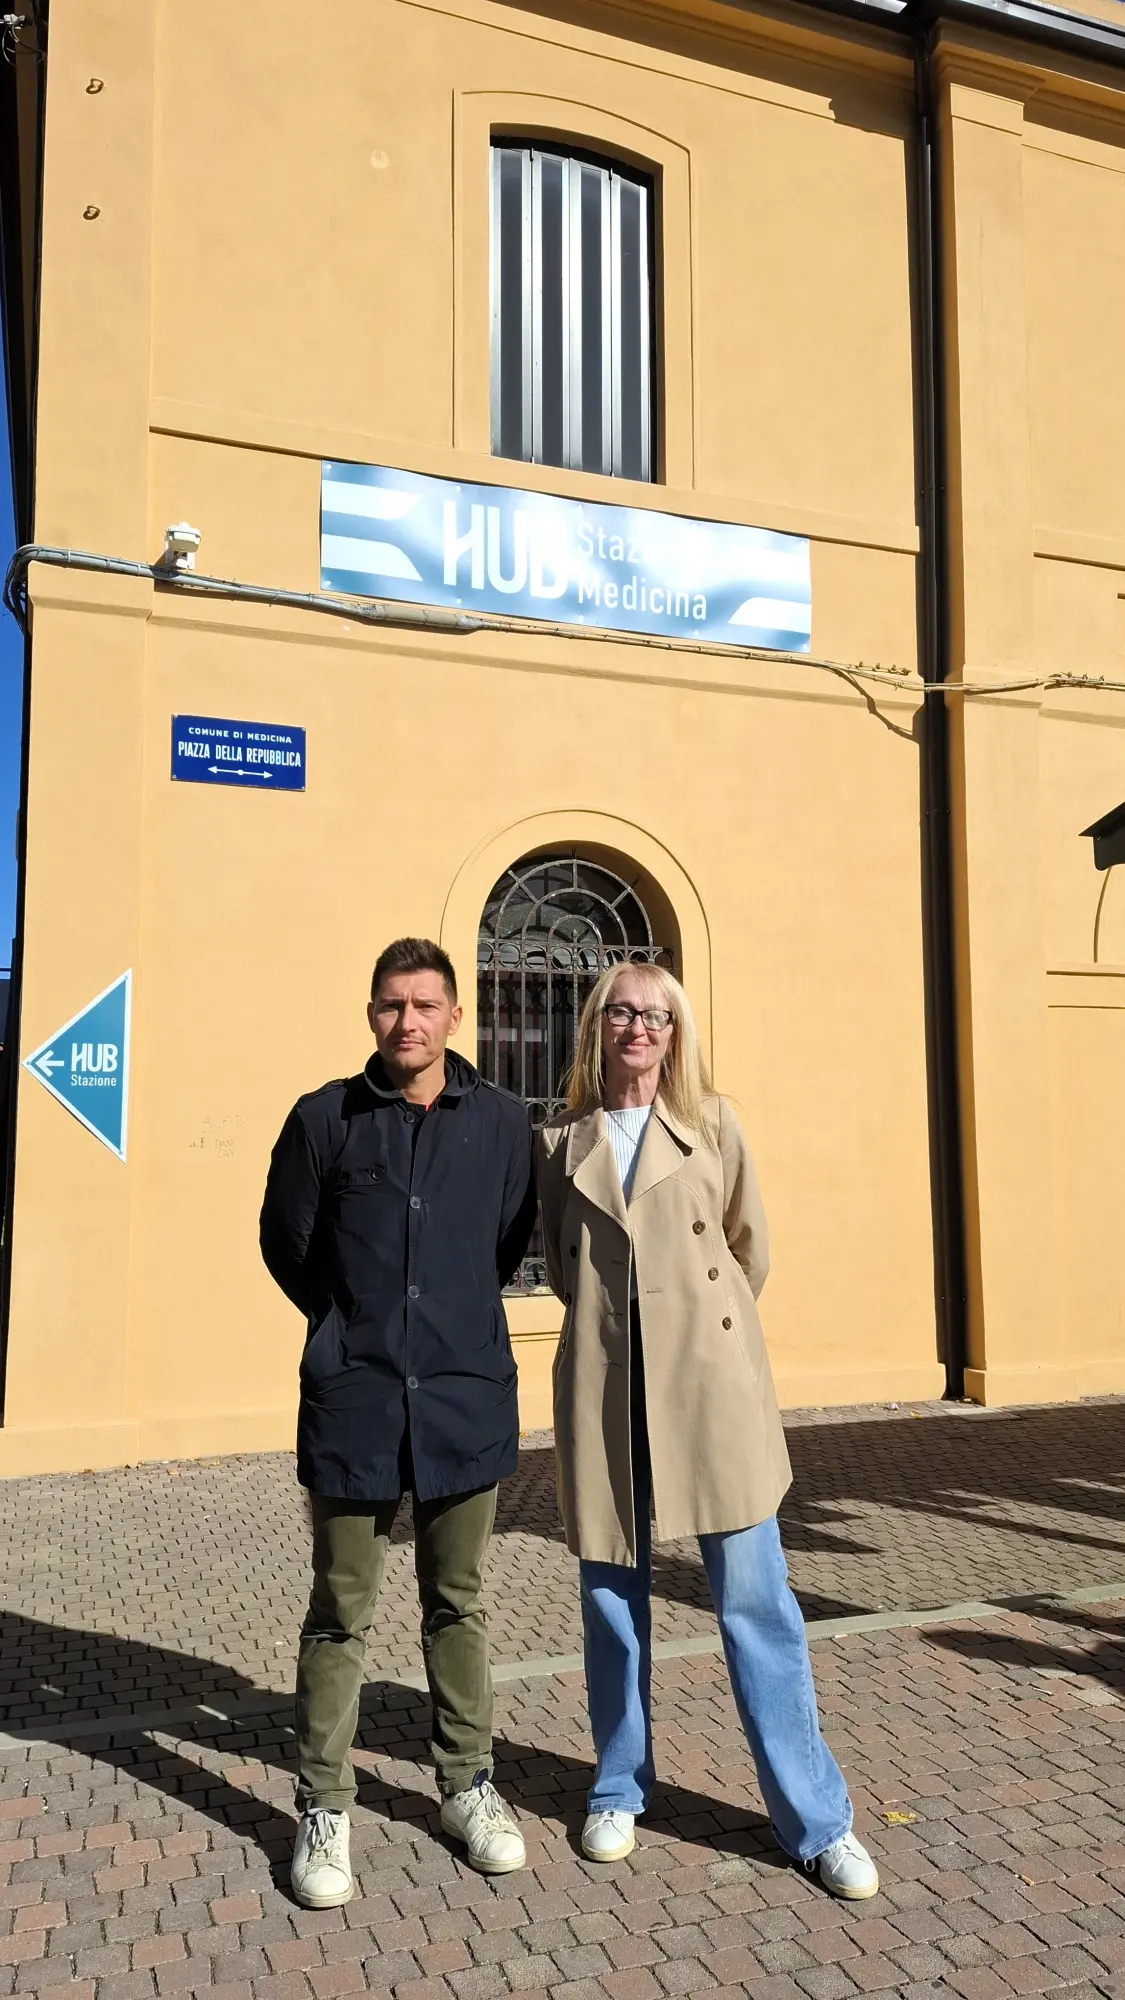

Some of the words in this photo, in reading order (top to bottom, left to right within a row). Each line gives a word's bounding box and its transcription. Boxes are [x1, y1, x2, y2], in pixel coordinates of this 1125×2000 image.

[578, 572, 707, 620] Medicina
[188, 727, 229, 738] COMUNE
[233, 731, 243, 739] DI
[247, 733, 292, 744] MEDICINA
[178, 741, 210, 758] PIAZZA
[215, 744, 242, 761] DELLA
[246, 747, 301, 767] REPUBBLICA
[71, 1043, 118, 1072] HUB
[71, 1074, 117, 1087] Stazione
